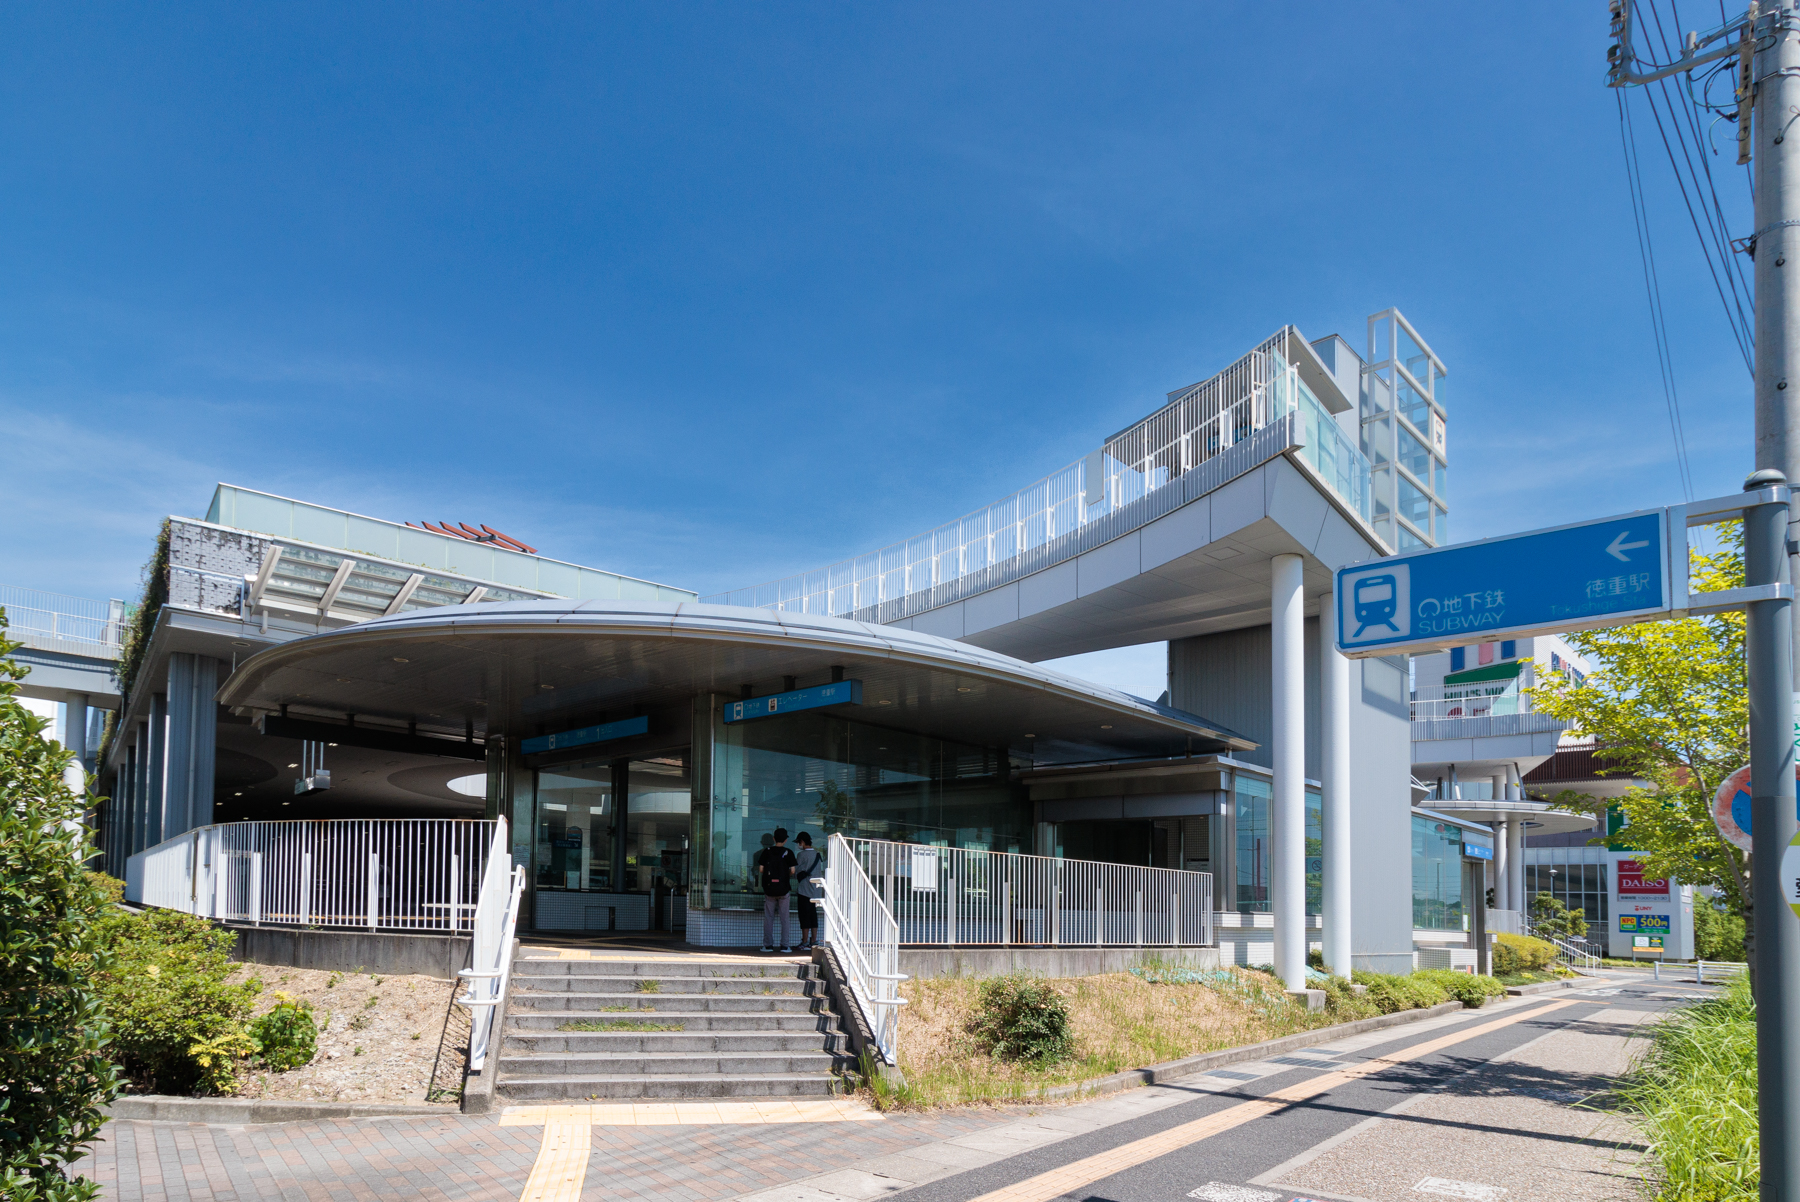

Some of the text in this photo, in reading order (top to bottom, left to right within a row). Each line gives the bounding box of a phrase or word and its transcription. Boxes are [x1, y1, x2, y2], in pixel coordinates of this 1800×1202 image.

[1585, 572, 1650, 598] 徳重駅
[1443, 589, 1506, 614] 地下鉄
[1549, 599, 1618, 616] Tokushige
[1418, 609, 1506, 634] SUBWAY
[1622, 879, 1665, 887] DAISO
